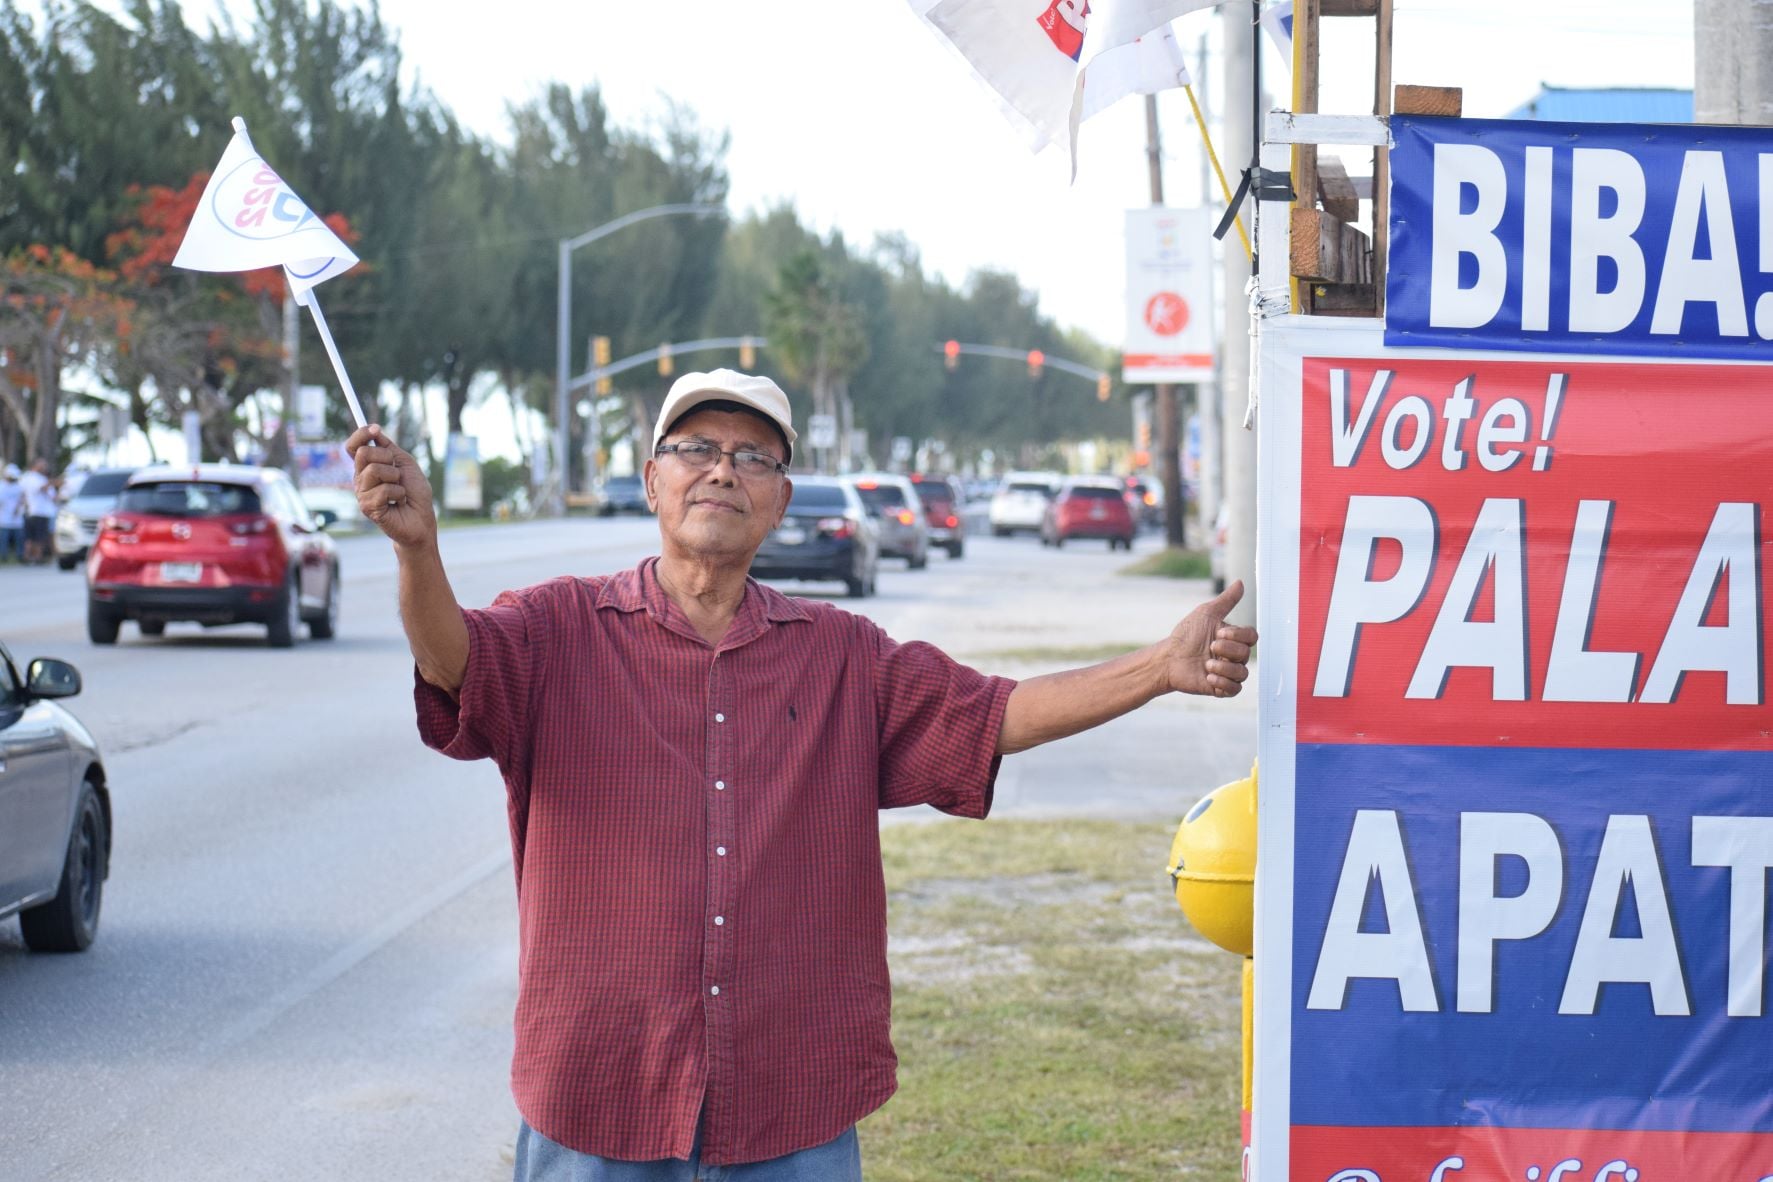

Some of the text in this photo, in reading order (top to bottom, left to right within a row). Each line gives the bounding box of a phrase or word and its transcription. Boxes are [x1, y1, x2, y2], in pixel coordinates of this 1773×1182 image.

[1430, 143, 1773, 341] BIBA!
[1329, 368, 1569, 472] Vote!
[1312, 495, 1765, 706] PALA
[1306, 808, 1773, 1018] APAT
